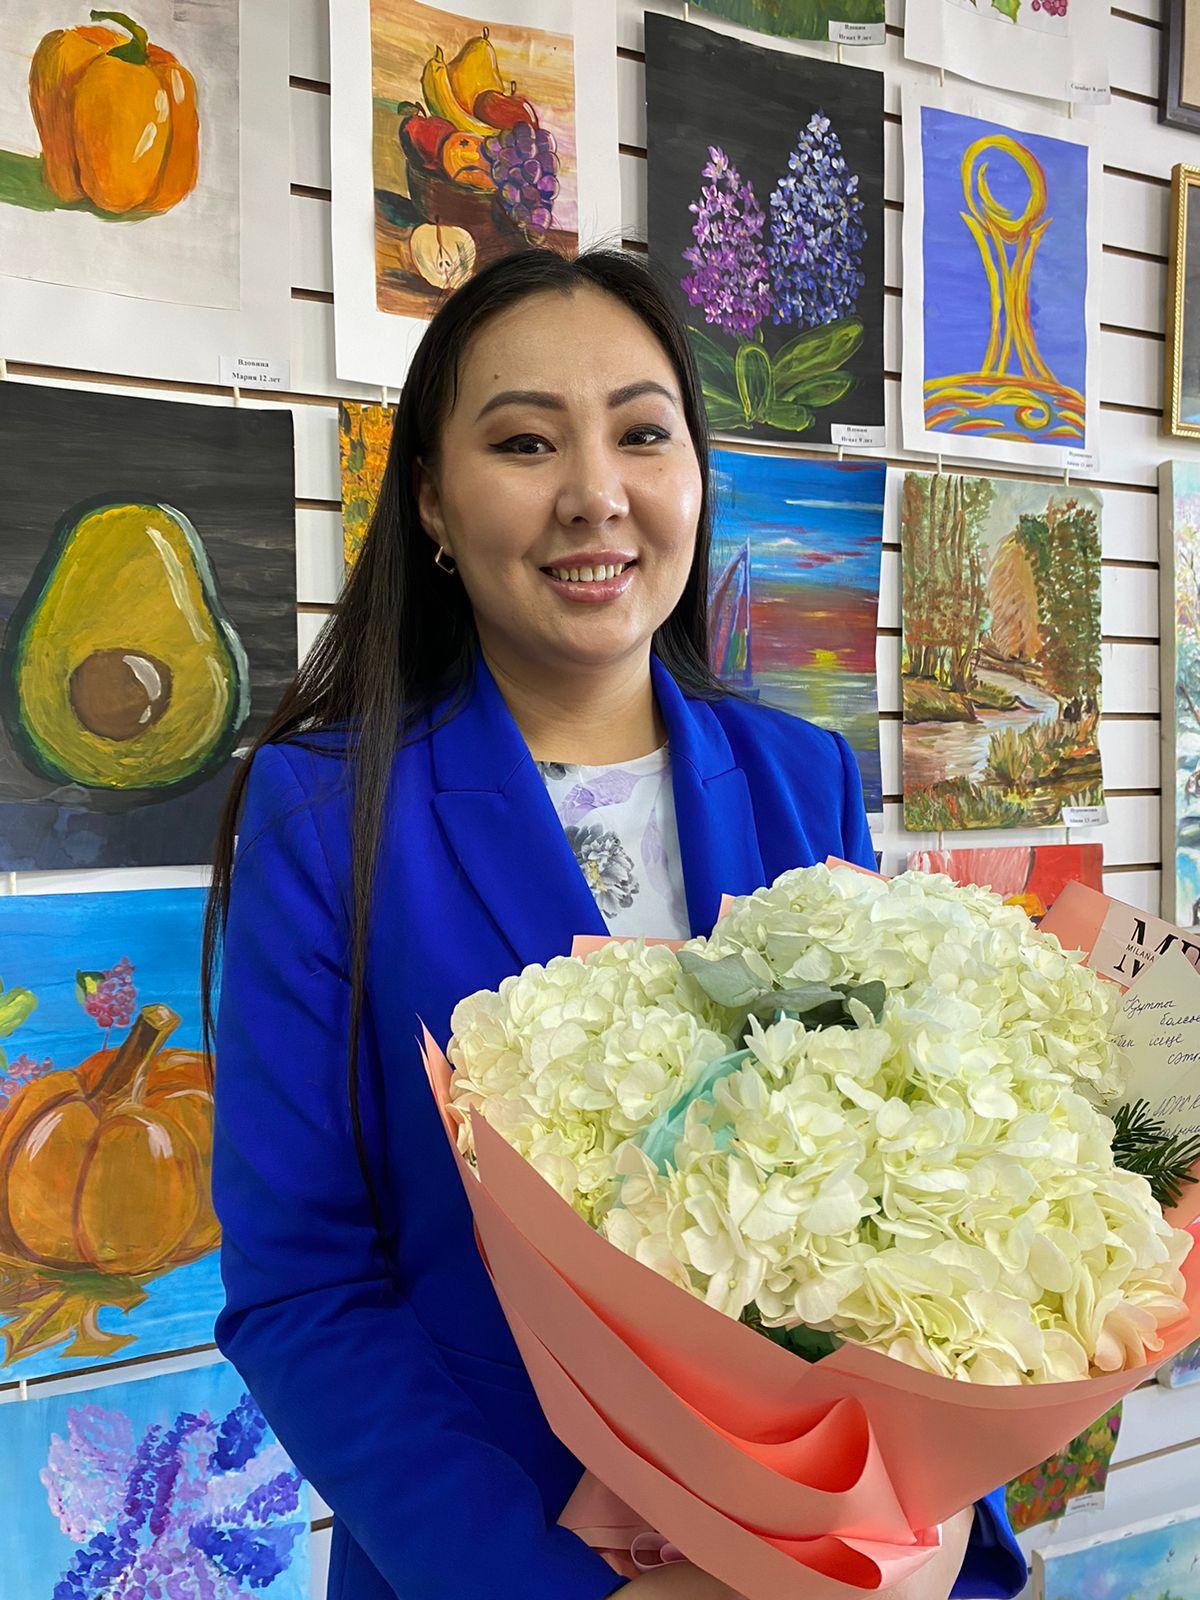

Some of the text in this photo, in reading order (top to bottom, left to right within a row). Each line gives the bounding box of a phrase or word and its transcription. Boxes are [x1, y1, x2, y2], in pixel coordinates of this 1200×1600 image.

[238, 359, 269, 368] Вдовина
[232, 372, 257, 382] Мария
[259, 374, 267, 382] 12
[1125, 944, 1156, 962] MILANA
